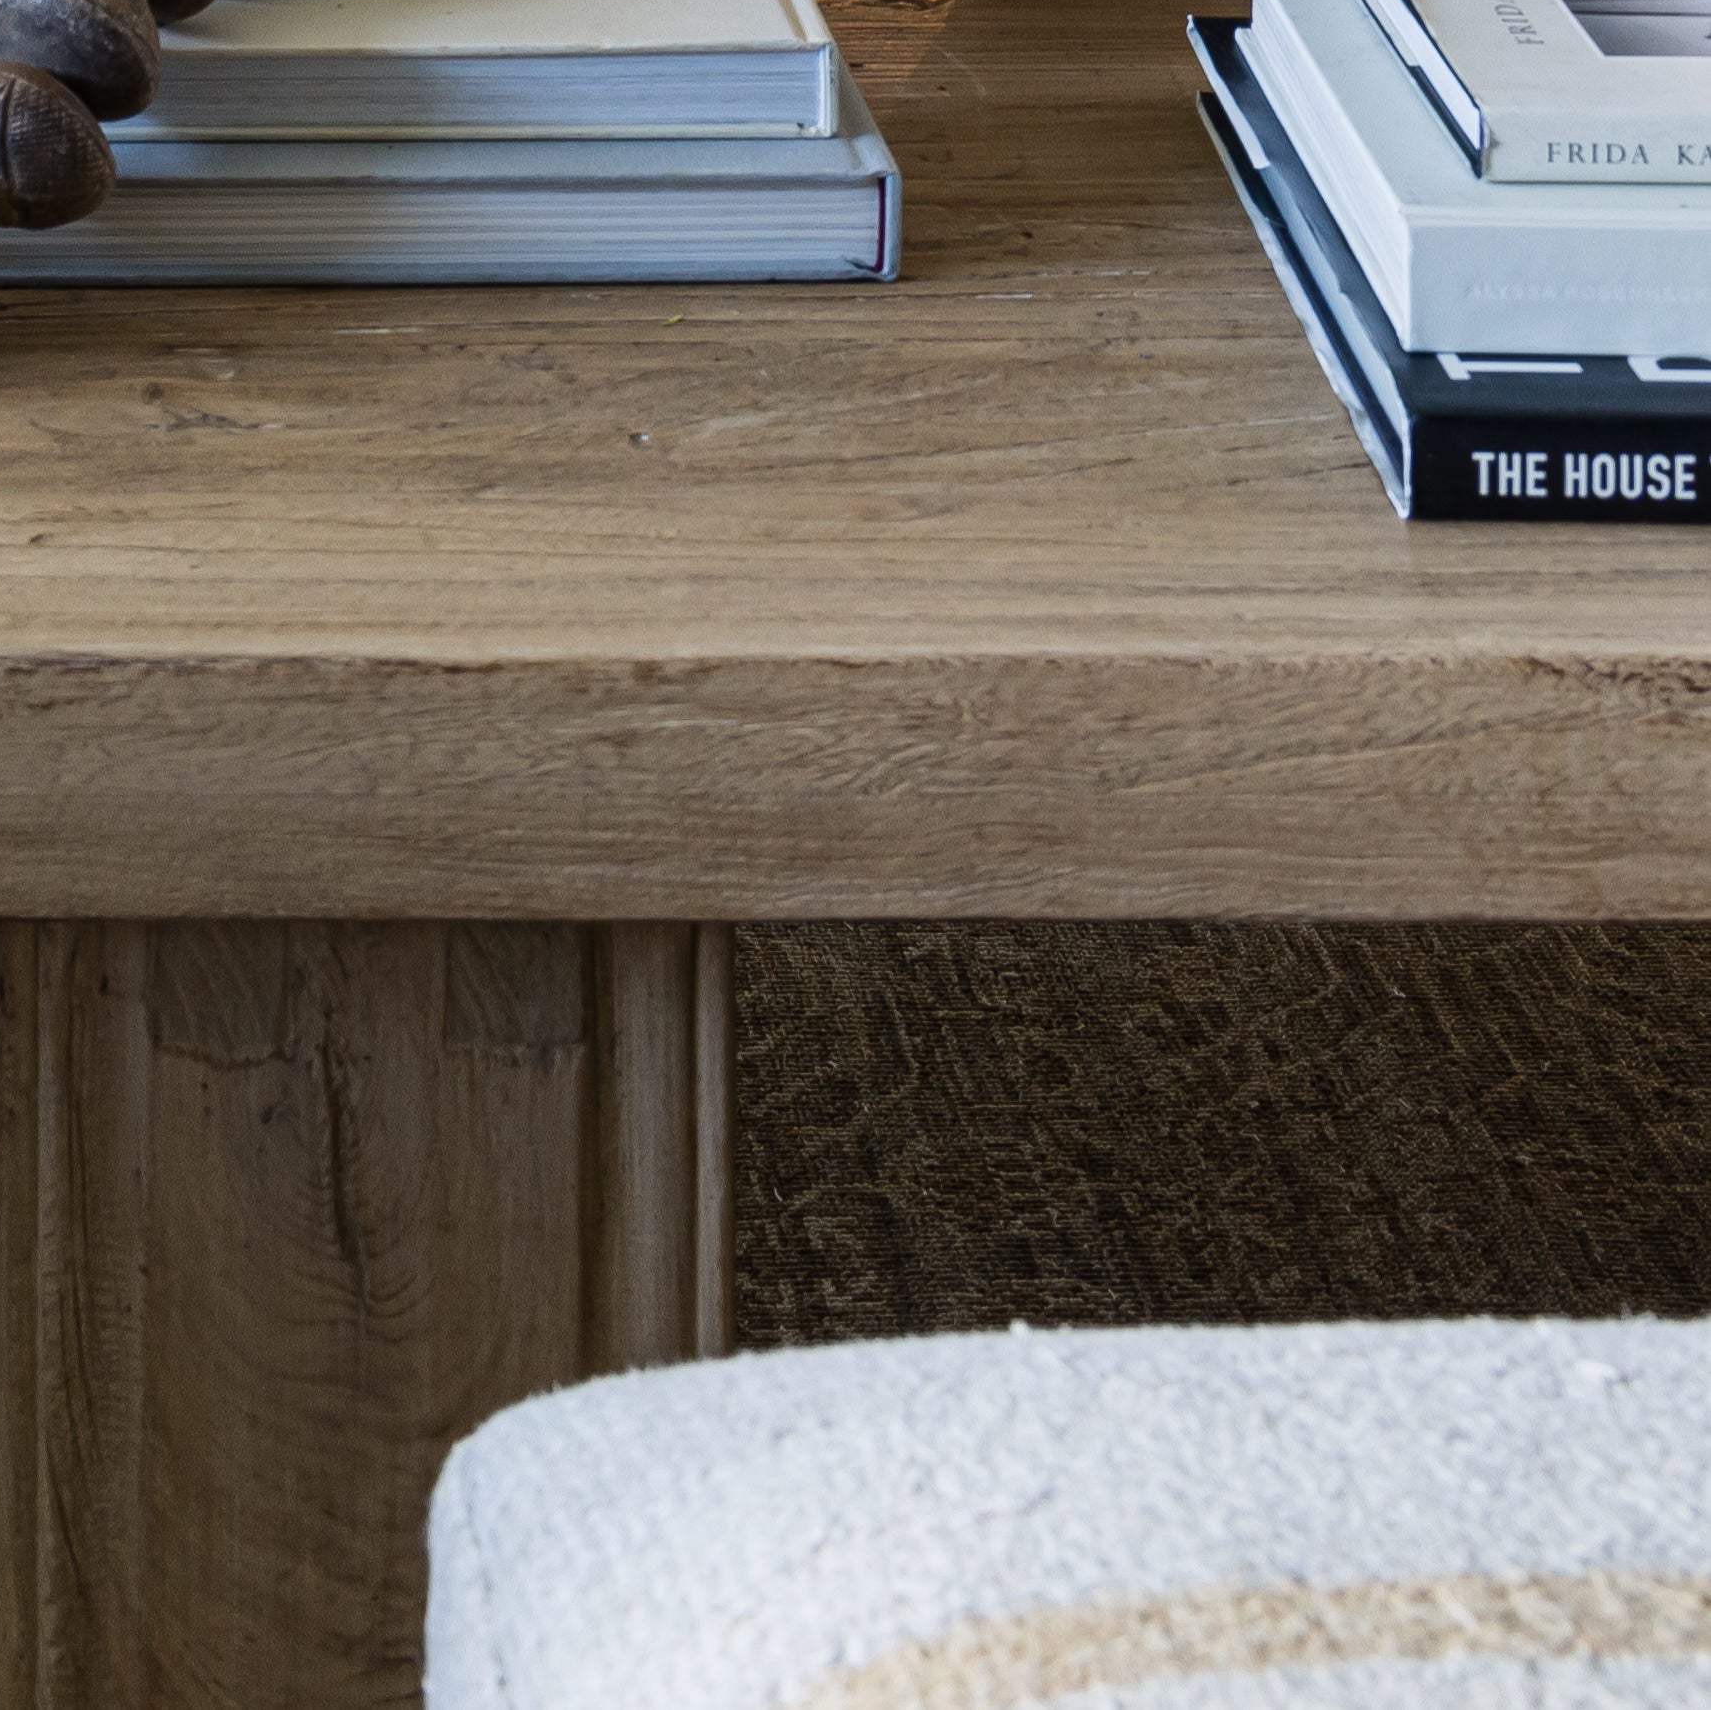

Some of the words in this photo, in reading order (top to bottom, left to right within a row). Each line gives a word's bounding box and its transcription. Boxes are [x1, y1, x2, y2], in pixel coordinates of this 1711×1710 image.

[1546, 141, 1650, 165] FRIDA
[1466, 281, 1557, 301] ALYSSA
[1471, 451, 1549, 498] THE
[1564, 452, 1697, 500] HOUSE
